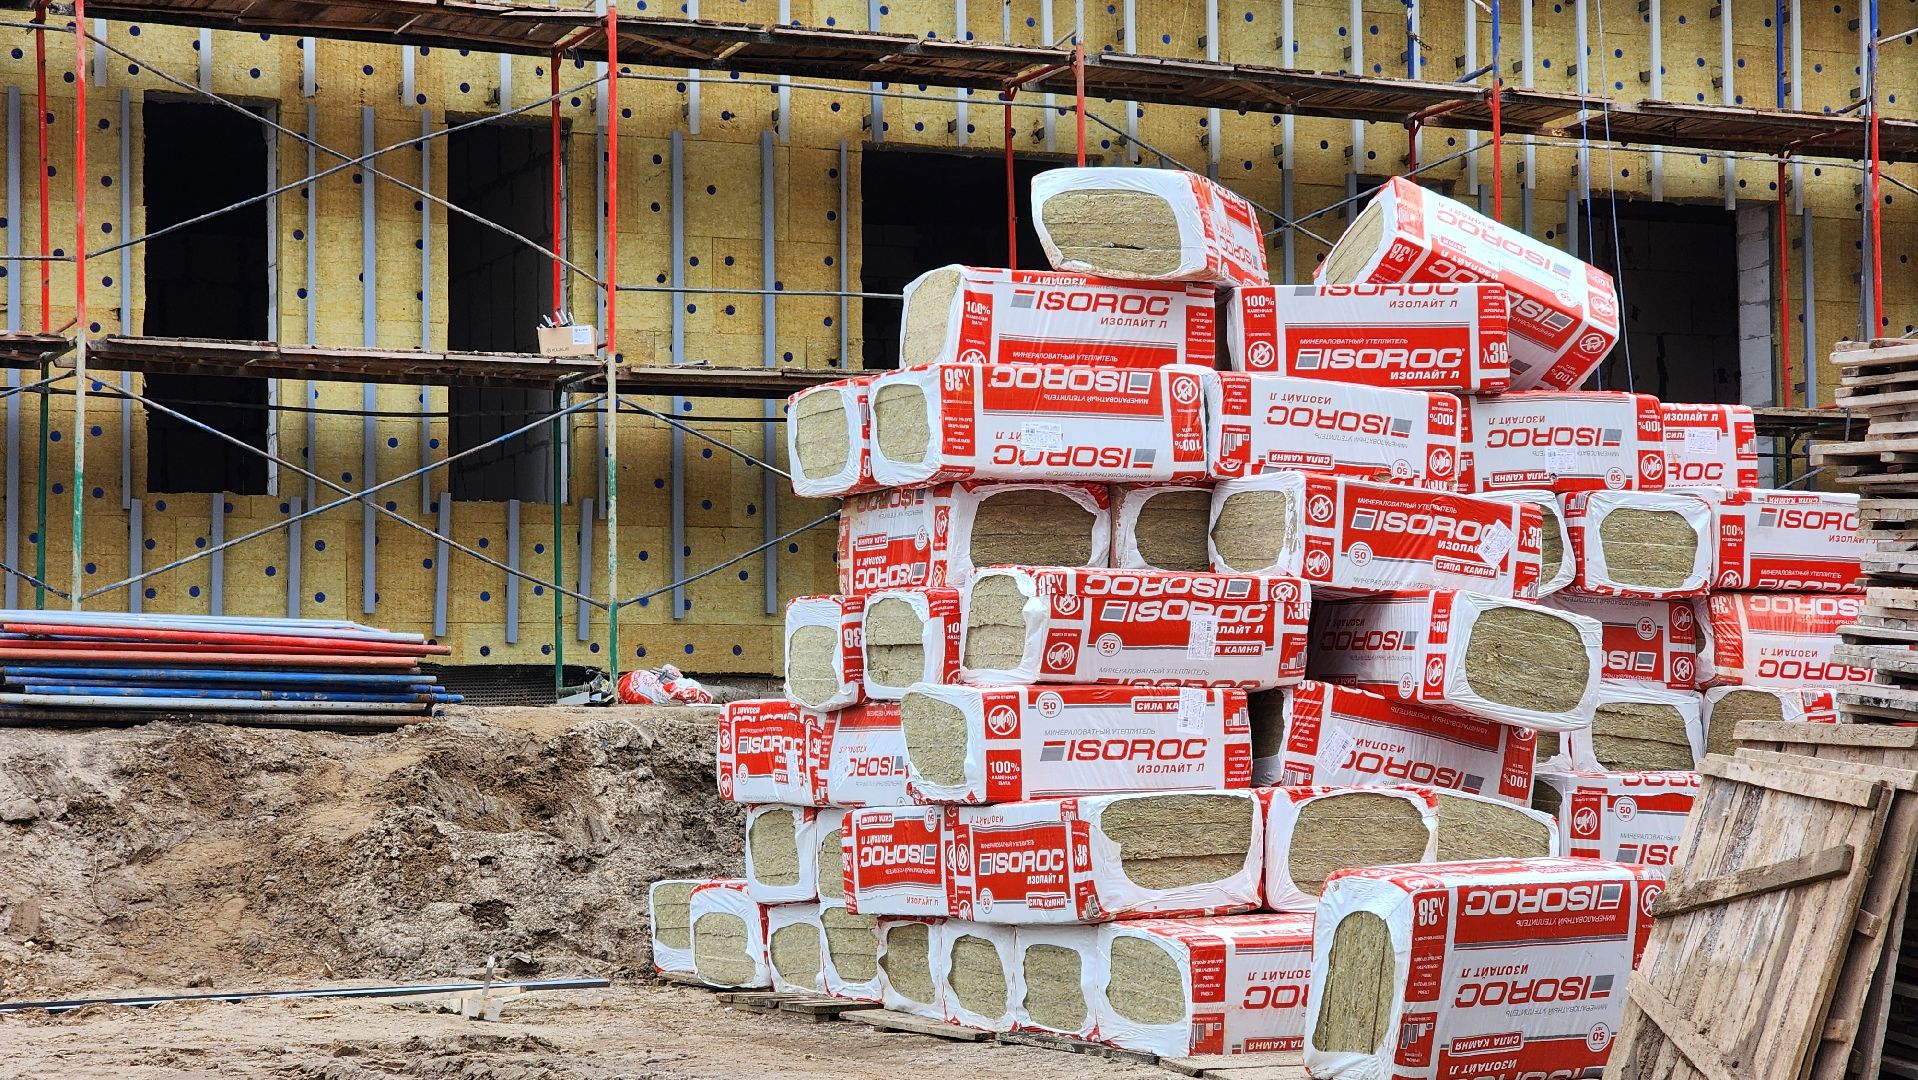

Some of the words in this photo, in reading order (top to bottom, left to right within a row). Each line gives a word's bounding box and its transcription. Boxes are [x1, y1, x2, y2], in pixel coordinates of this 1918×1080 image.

[1452, 255, 1499, 280] ИЗОЛАЙТ
[1320, 284, 1459, 297] ISOROC
[1036, 290, 1170, 316] ISOROC
[1245, 295, 1275, 307] 100%
[1389, 300, 1443, 308] ИЗОЛАЙТ
[965, 300, 991, 314] 100%
[1101, 317, 1154, 327] ИЗОЛАЙТ
[1158, 320, 1167, 328] Л
[1013, 351, 1076, 361] МИНЕРАЛОВАТНЫЙ
[1077, 353, 1118, 362] УТЕПЛИТЕЛЬ
[1321, 348, 1462, 368] ISOROC
[1390, 370, 1446, 380] ИЗОЛАЙТ
[1450, 371, 1459, 379] Л
[1552, 369, 1574, 386] 100%
[991, 368, 1126, 394] ISOROC
[1043, 393, 1085, 402] УТЕПЛИТЕЛЬ
[1087, 396, 1149, 404] МИНЕРАЛОВАТНЫЙ
[1270, 392, 1277, 400] Л
[1281, 395, 1332, 404] ИЗОЛАЙТ
[1267, 405, 1391, 435] ISOROC
[1429, 413, 1455, 425] 100%
[1488, 416, 1495, 425] Л
[1499, 415, 1546, 424] ИЗОЛАЙТ
[1664, 412, 1707, 421] ИЗОЛАЙТ
[1638, 421, 1662, 432] 100%
[1487, 427, 1602, 448] ISOROC
[1175, 440, 1201, 451] 100%
[1272, 454, 1303, 462] КАМНЯ
[1306, 455, 1330, 464] СИЛА
[1396, 467, 1408, 475] 50
[1668, 463, 1724, 480] ROC
[1494, 473, 1526, 482] КАМНЯ
[1610, 474, 1621, 482] 50
[1357, 498, 1417, 509] МИНЕРАЛОВАТНЫЙ
[1777, 511, 1859, 531] ISORO
[1721, 524, 1744, 536] 100%
[1354, 551, 1367, 559] 50
[1437, 562, 1461, 572] СИЛА
[1464, 565, 1495, 577] КАМНЯ
[856, 563, 913, 589] ISOROC
[1084, 577, 1222, 599] ISOROC
[1431, 621, 1447, 632] 100%
[1102, 641, 1115, 650] 50
[1322, 631, 1403, 650] ISOROC
[1224, 645, 1259, 654] КАМНЯ
[1771, 648, 1818, 658] ИЗОЛАЙТ
[1099, 667, 1164, 675] МИНЕРАЛОВАТНЫЙ
[1758, 660, 1875, 682] ISOROC
[1402, 680, 1410, 688] 50
[1042, 702, 1056, 710] 50
[1137, 702, 1163, 711] СИЛА
[1045, 728, 1111, 736] МИНЕРАЛОВАТНЫЙ
[1067, 739, 1207, 761] ISOROC
[1356, 738, 1405, 754] ИЗОЛАЙ
[989, 761, 1020, 774] 100%
[1137, 764, 1191, 774] ИЗОЛАЙТ
[1196, 764, 1204, 772] Л
[1504, 773, 1528, 788] 100%
[861, 845, 924, 867] ISOROC
[992, 849, 1064, 873] ISOROC
[1027, 874, 1055, 885] ИЗОЛАЙТ
[1058, 875, 1064, 883] Л
[1464, 885, 1601, 916] ISOROC
[1516, 918, 1556, 927] УТЕПЛИТЕЛЬ
[1557, 914, 1616, 928] МИНЕРАЛОВАТНЫЙ
[1247, 972, 1256, 981] Л
[1261, 970, 1311, 983] ЗОЛАЙТ
[1461, 968, 1470, 978] Л
[1474, 964, 1528, 979] ИЗОЛАЙТ
[1455, 975, 1591, 1008] ISOROC
[1505, 1007, 1548, 1017] УТЕПЛИТЕЛЬ
[1549, 1004, 1608, 1015] МИНЕРАЛОВАТНЫЙ
[1493, 1036, 1519, 1047] СИЛА
[1592, 1032, 1605, 1041] 50
[1248, 1040, 1286, 1050] КАМНЯ
[1456, 1039, 1490, 1051] КАМНЯ
[1450, 1064, 1458, 1075] Л
[1461, 1058, 1516, 1074] ИЗОЛАЙТ
